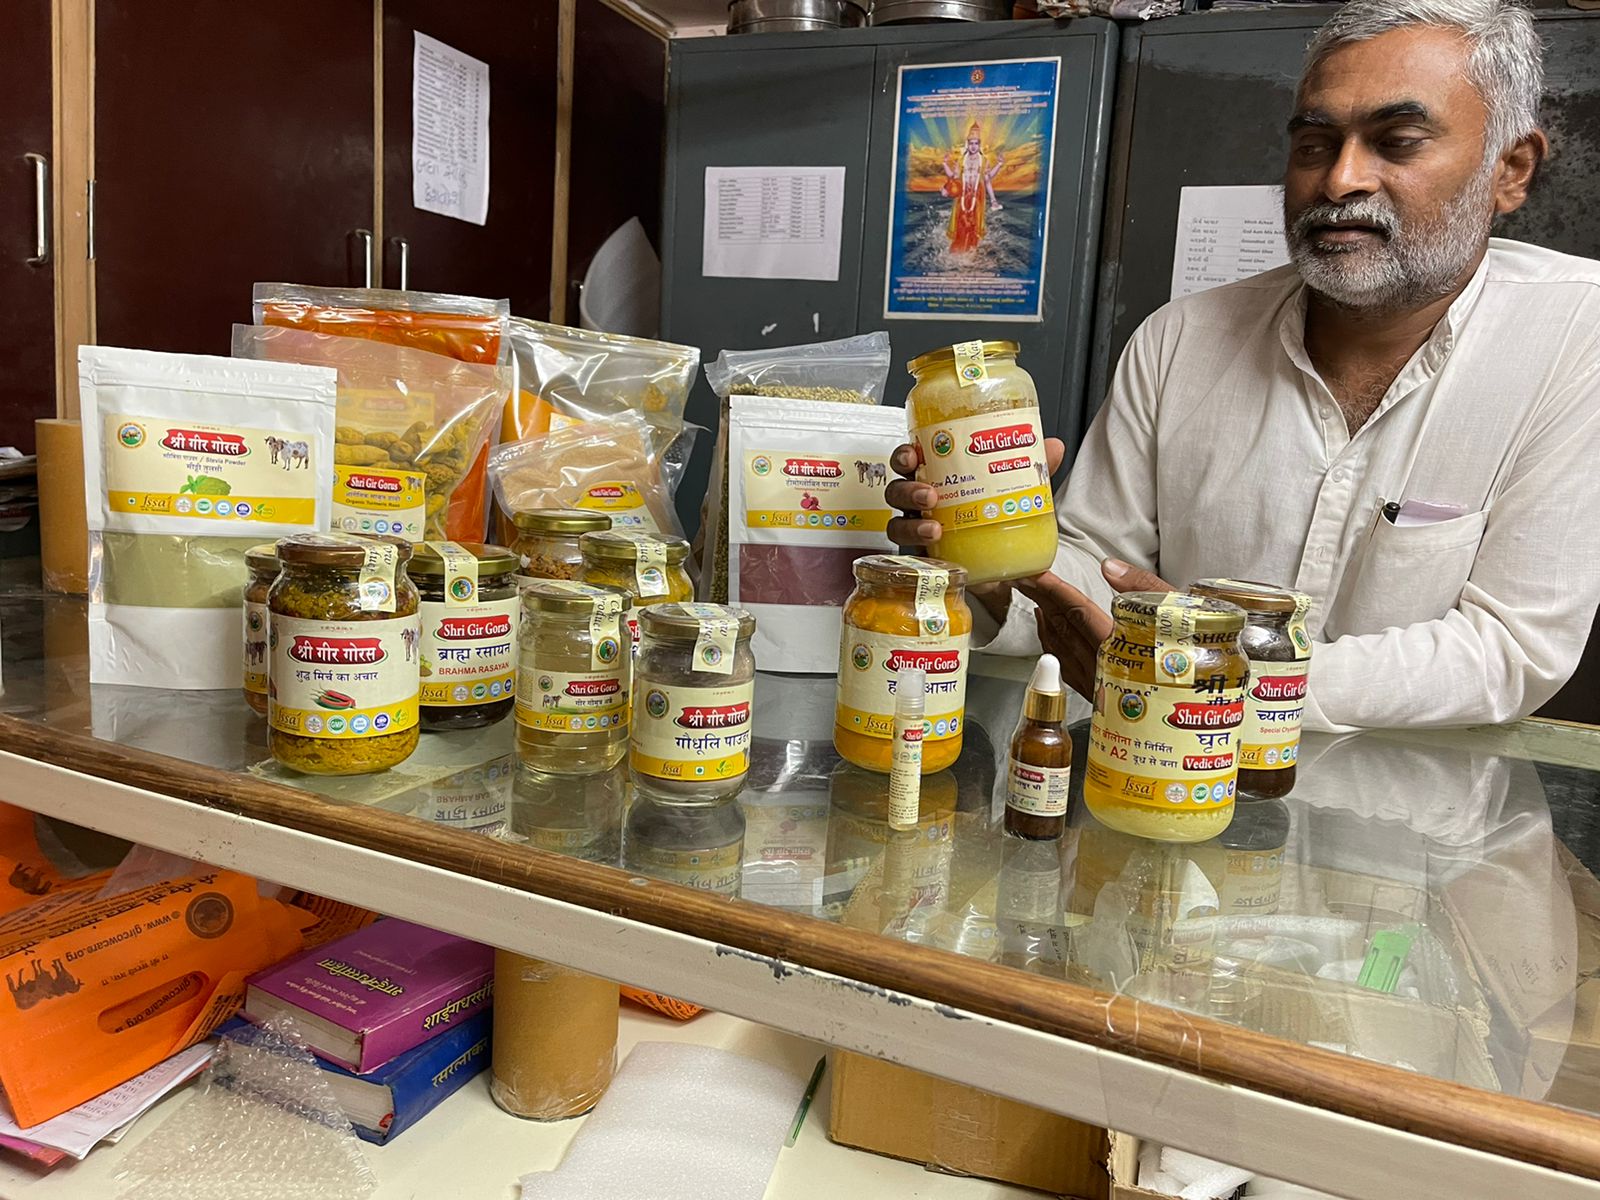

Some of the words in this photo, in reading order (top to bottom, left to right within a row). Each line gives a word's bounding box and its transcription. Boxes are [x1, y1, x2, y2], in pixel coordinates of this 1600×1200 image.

[170, 433, 186, 450] श्री
[188, 435, 209, 452] गीर
[211, 436, 242, 455] गोरस
[973, 434, 996, 453] Shri
[996, 432, 1013, 450] Gir
[224, 458, 247, 467] Powder
[787, 461, 799, 476] श्री
[801, 462, 815, 476] गीर
[816, 463, 838, 477] गोरस
[990, 461, 1012, 474] Vedic
[1013, 458, 1031, 470] Ghee
[350, 475, 366, 488] Shri
[365, 477, 378, 489] Gir
[944, 474, 959, 486] A2
[959, 474, 977, 483] Milk
[960, 487, 985, 497] Beater
[443, 623, 465, 638] Shri
[467, 622, 485, 636] Gir
[485, 619, 509, 635] Goras
[297, 641, 313, 661] श्री
[315, 641, 340, 663] गीर
[342, 642, 378, 663] गोरस
[475, 642, 512, 659] रसायन
[438, 666, 478, 676] BRAHMA
[478, 661, 510, 674] RASAYAN
[892, 655, 915, 670] Shri
[915, 656, 934, 671] Gir
[934, 655, 958, 671] Goras
[1106, 652, 1145, 671] संस्थान
[295, 669, 311, 683] शुद्ध
[313, 668, 334, 681] मिर्च
[336, 672, 350, 682] का
[353, 670, 380, 681] अचार
[569, 684, 587, 696] Shri
[587, 683, 600, 695] Gir
[1259, 682, 1282, 698] Shri
[1283, 682, 1298, 698] Gir
[688, 709, 704, 728] श्री
[706, 708, 726, 727] गीर
[726, 705, 748, 725] गोरस
[1176, 708, 1203, 727] Shri
[1203, 708, 1222, 727] Gir
[1222, 706, 1244, 725] Goras
[1259, 726, 1281, 735] Special
[674, 731, 722, 755] गौधूलि
[1133, 737, 1143, 749] से
[1143, 740, 1174, 754] निर्मित
[1195, 731, 1232, 754] घृत
[1109, 745, 1128, 761] A2
[1132, 754, 1146, 766] दूध
[1148, 755, 1158, 766] से
[1159, 758, 1179, 768] बना
[1184, 756, 1213, 771] Vedic
[1213, 755, 1233, 769] Ghee
[145, 912, 172, 931] www.
[65, 922, 143, 963] gircowcare.org
